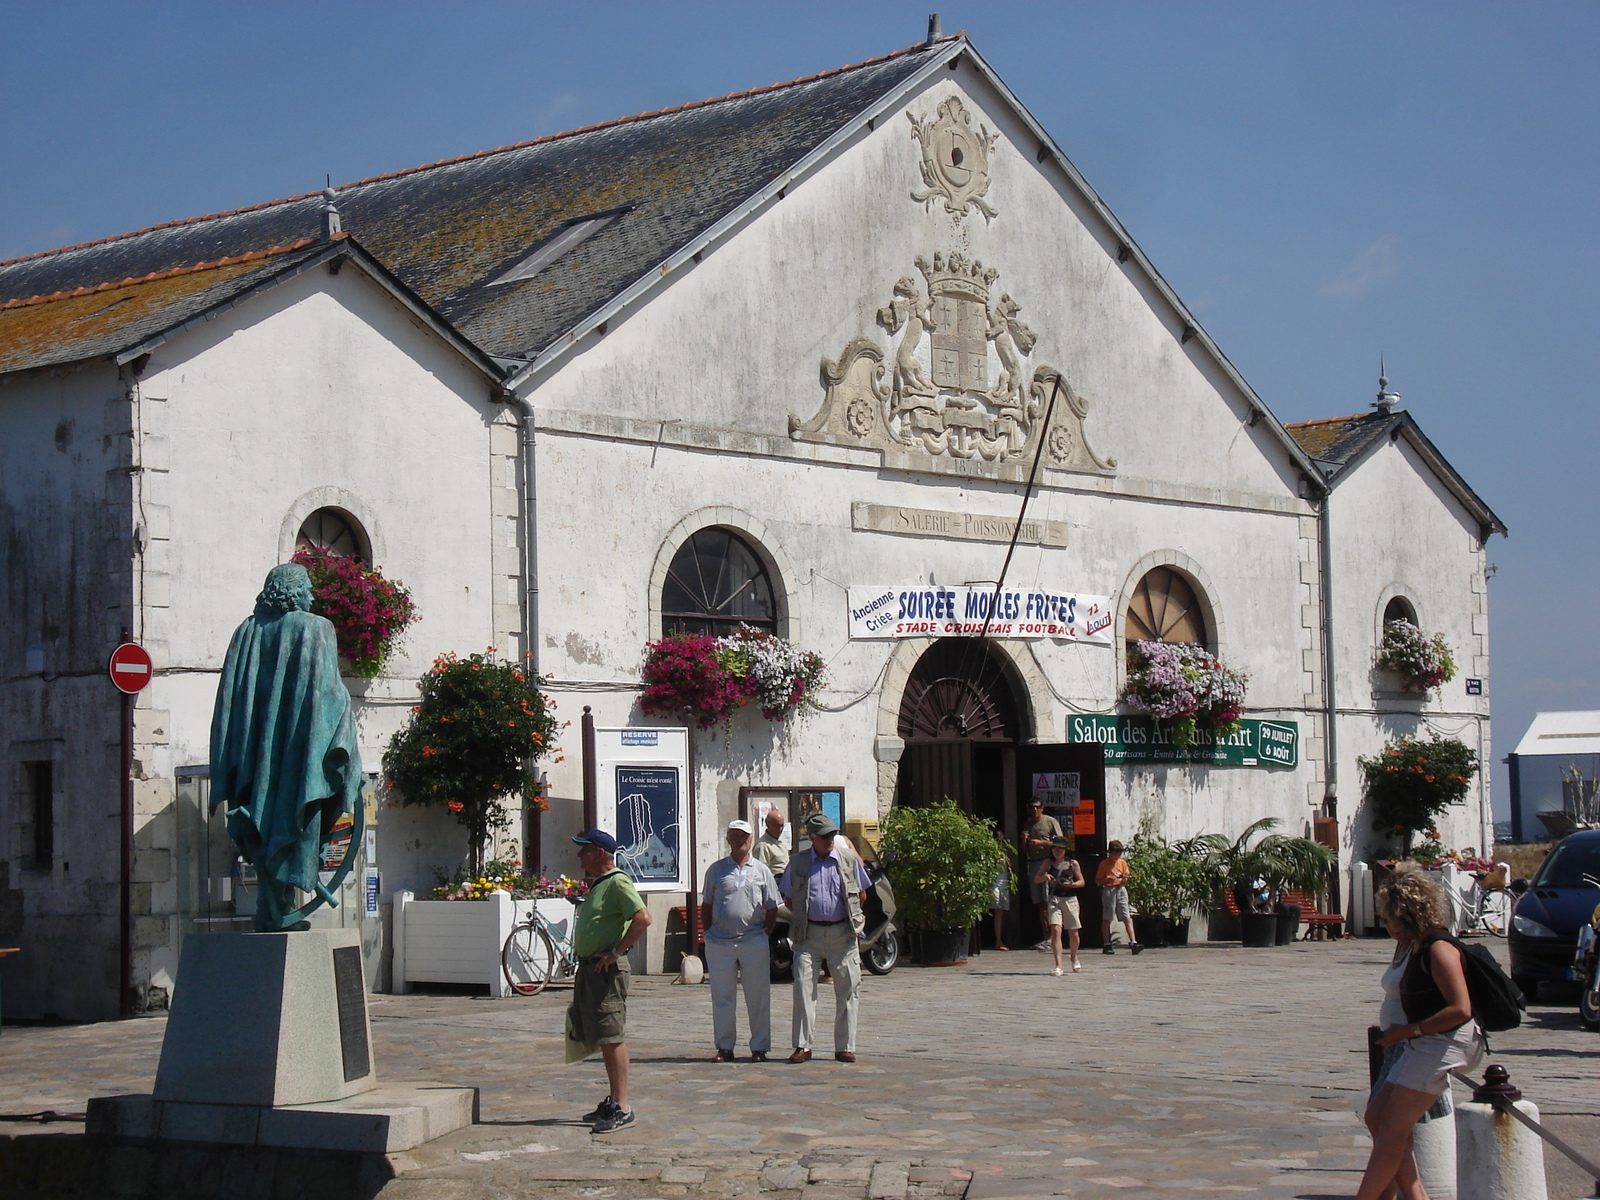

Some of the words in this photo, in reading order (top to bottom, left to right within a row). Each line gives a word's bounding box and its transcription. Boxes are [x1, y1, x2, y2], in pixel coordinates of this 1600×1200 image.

[851, 591, 895, 622] Ancienne
[898, 591, 956, 621] SOIREE
[965, 591, 1020, 620] MOULES
[1026, 593, 1077, 623] FRITES
[1087, 603, 1099, 616] 12
[865, 611, 894, 632] Criée
[896, 622, 937, 633] STADE
[944, 623, 1012, 634] CROISCAIS
[1019, 624, 1076, 637] FOOTBALL
[1089, 615, 1109, 631] AOUT
[1074, 717, 1118, 744] Salon
[1122, 719, 1147, 744] des
[1261, 727, 1271, 739] 29
[1271, 729, 1294, 744] JUILLET
[1115, 749, 1146, 758] artisans
[1153, 749, 1175, 759] Entrée
[1265, 744, 1272, 756] 6
[1273, 745, 1290, 760] AOÛT
[621, 775, 629, 783] Le
[1054, 773, 1079, 789] DERNIER
